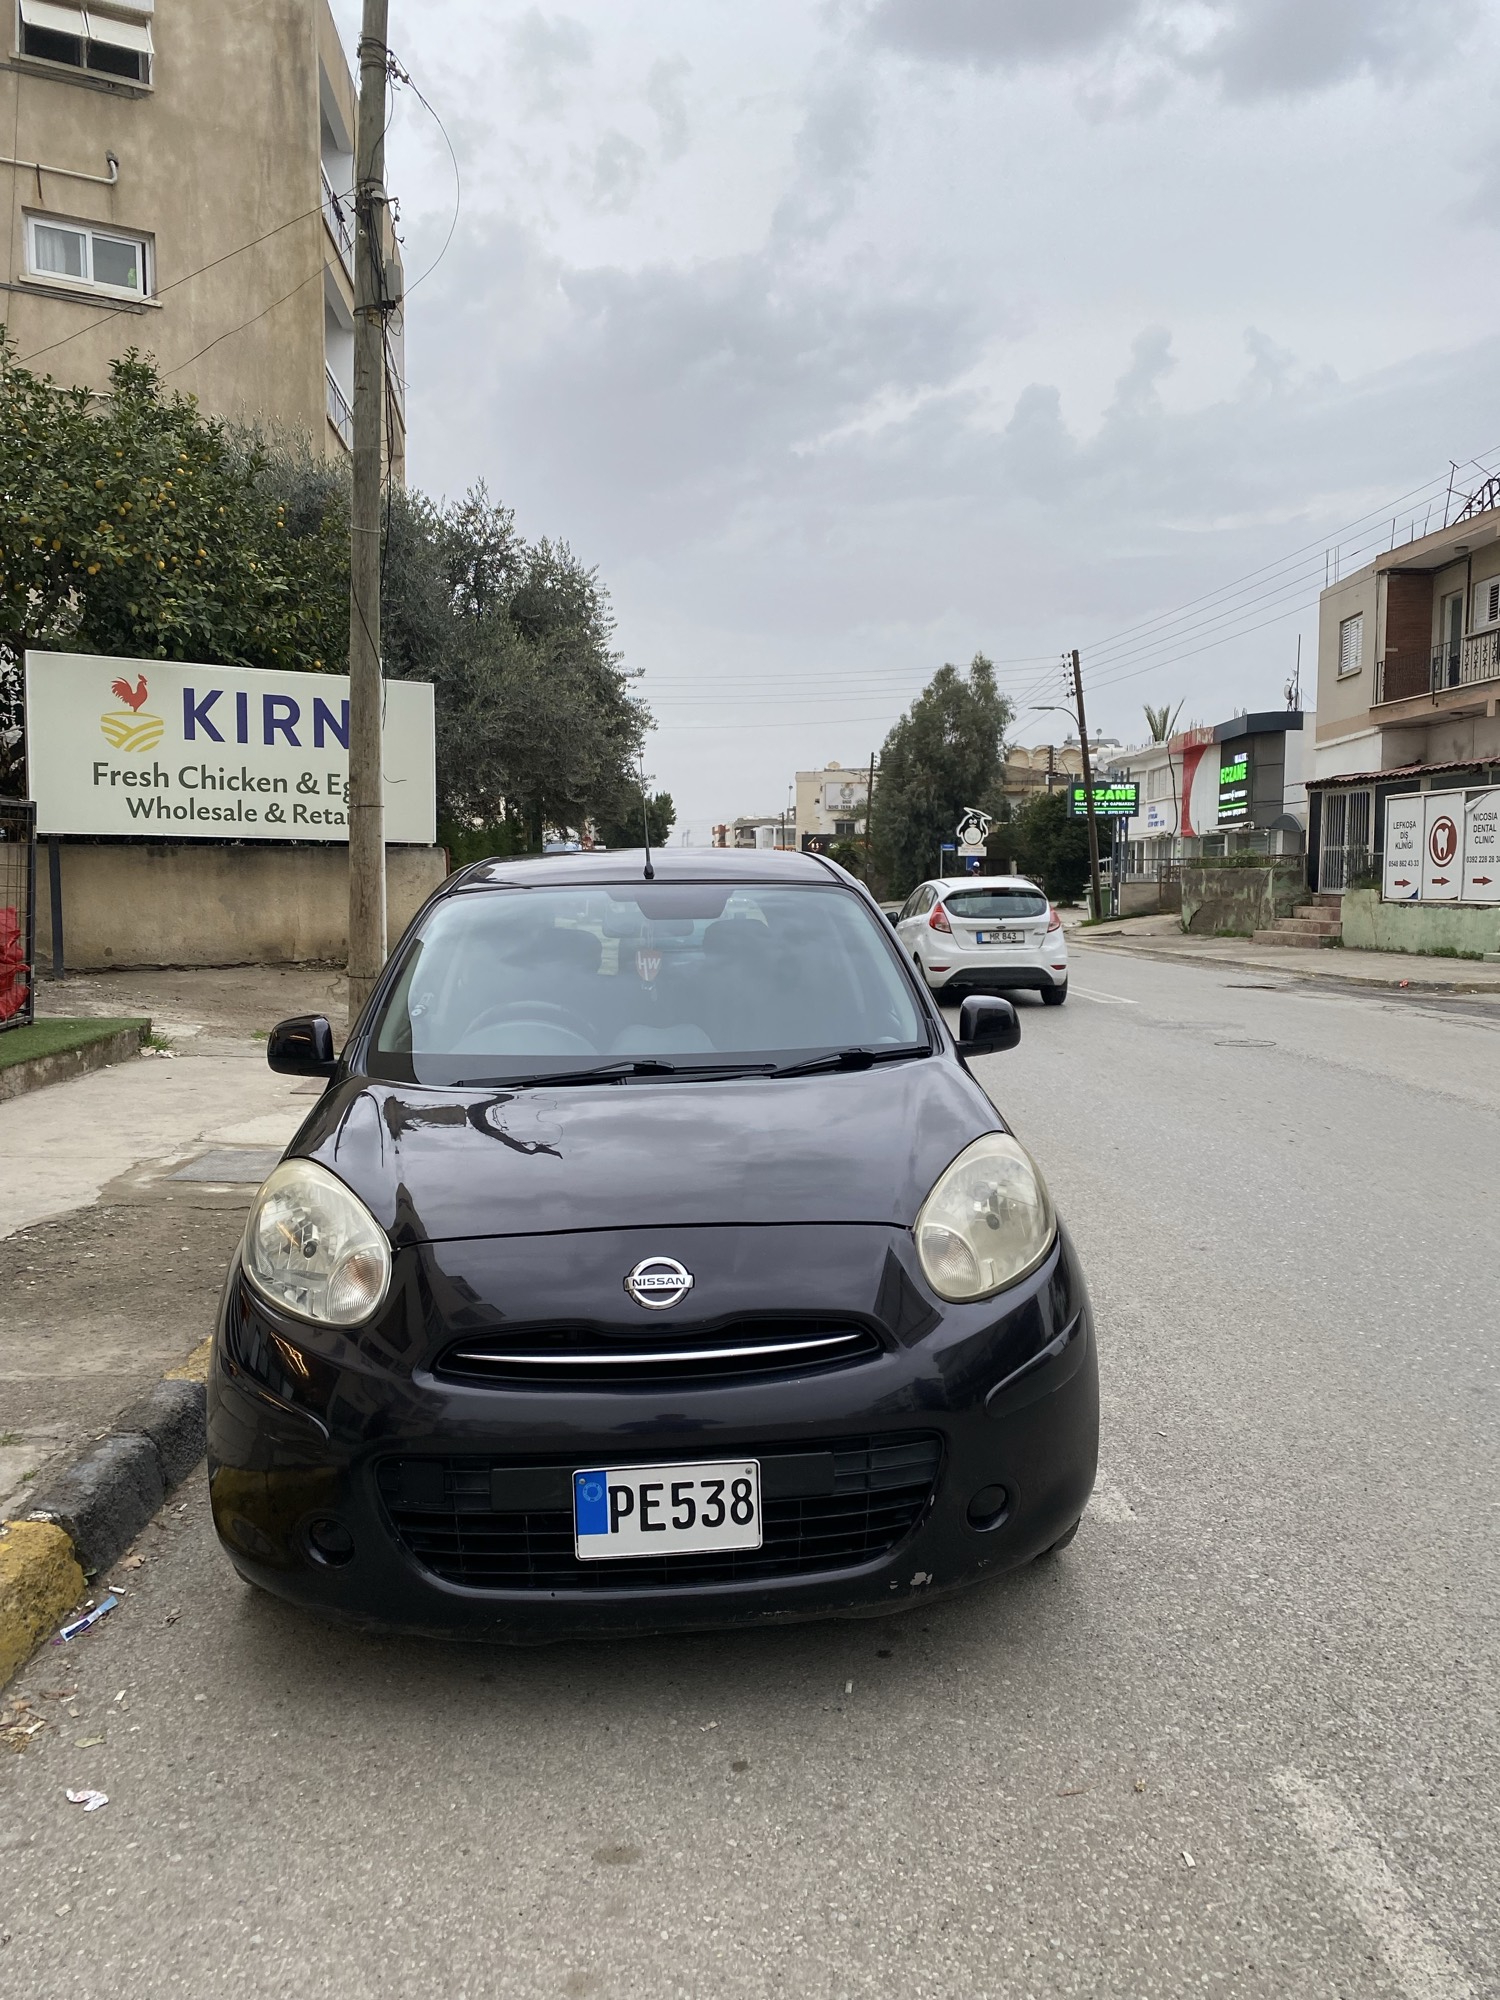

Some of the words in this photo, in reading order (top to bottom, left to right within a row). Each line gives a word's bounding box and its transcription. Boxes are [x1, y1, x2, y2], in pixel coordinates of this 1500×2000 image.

[183, 687, 350, 750] KIRN
[1220, 762, 1247, 784] ECZANE
[93, 762, 169, 788] Fresh
[178, 764, 288, 793] Chicken
[296, 772, 320, 795] &
[327, 773, 350, 804] Eg
[125, 795, 258, 822] Wholesale
[264, 802, 286, 823] &
[292, 803, 350, 825] Retai
[1473, 812, 1498, 821] NICOSIA
[1393, 821, 1416, 830] LEFKOŞA
[1473, 824, 1496, 833] DENTAL
[1474, 835, 1495, 844] CLINIC
[1002, 932, 1017, 940] 843
[632, 1277, 686, 1287] NISSAN
[608, 1478, 754, 1533] PE538
